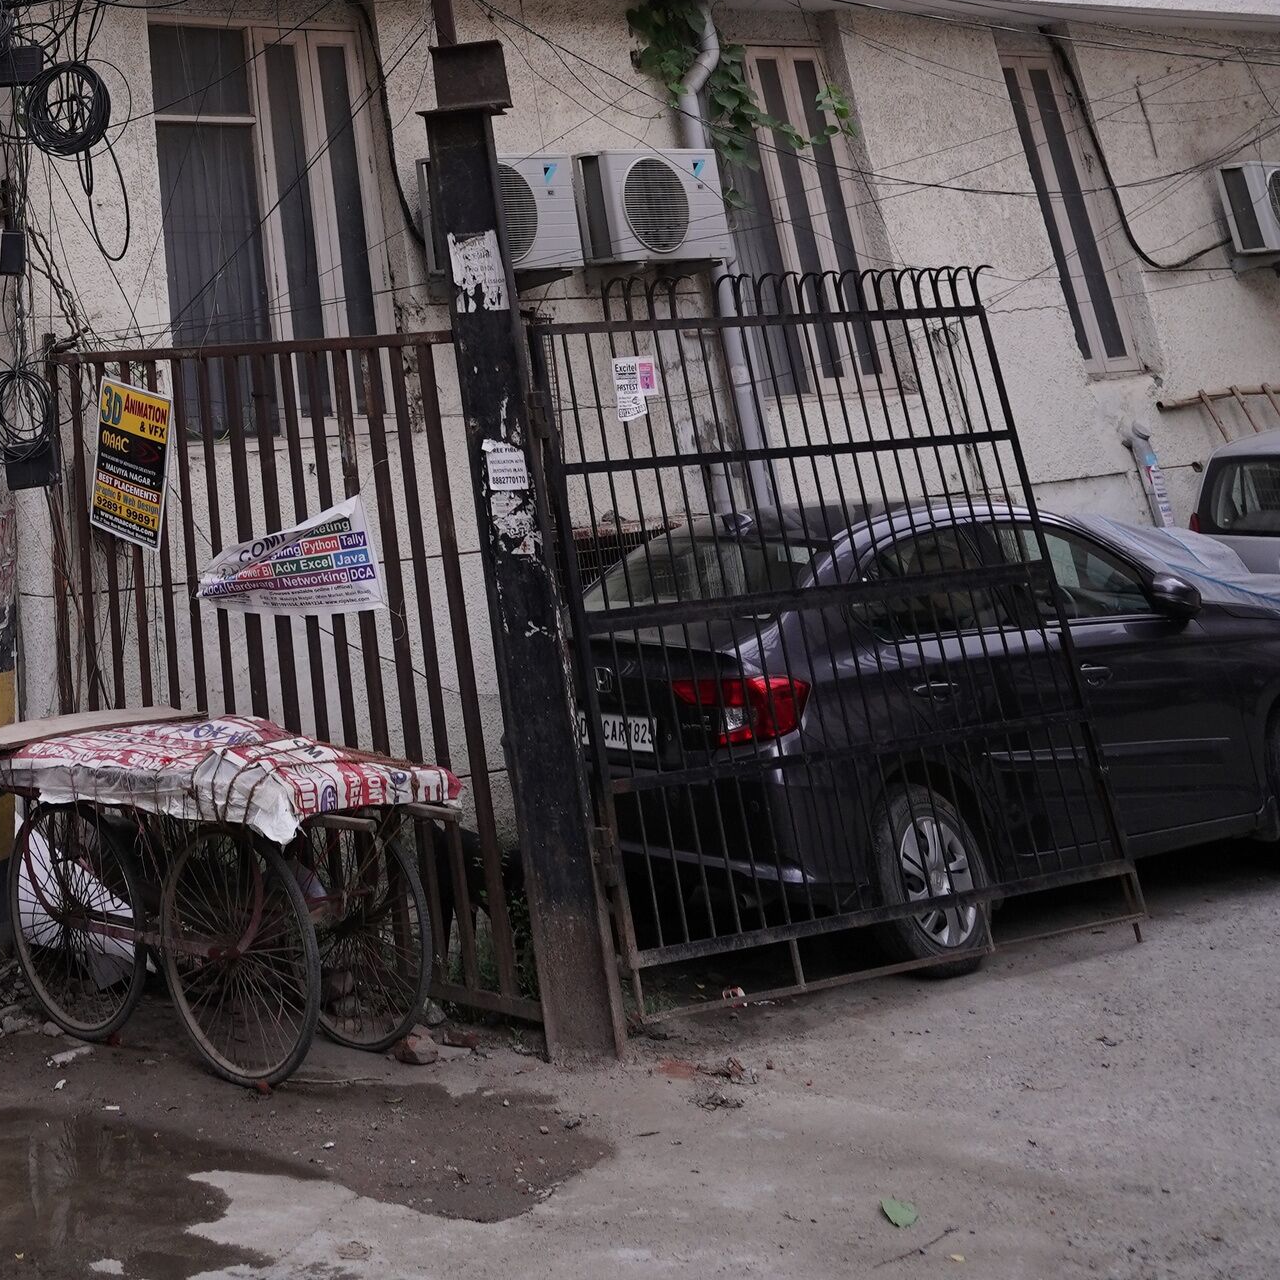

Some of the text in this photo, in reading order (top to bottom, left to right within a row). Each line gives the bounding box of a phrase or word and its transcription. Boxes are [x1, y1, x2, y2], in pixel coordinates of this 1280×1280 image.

[615, 363, 637, 372] Excitel
[101, 386, 122, 426] 3D
[102, 429, 130, 453] MAAC
[139, 421, 165, 439] & VFX
[105, 461, 129, 477] MALVIYA
[129, 470, 151, 485] NAGAR
[98, 471, 158, 502] BEST PLACEMENTS
[97, 496, 157, 527] 92891 99891
[303, 537, 339, 555] Python
[340, 533, 365, 549] Tally
[275, 561, 297, 574] Adv
[300, 557, 332, 571] Excel
[336, 552, 367, 567] Java
[227, 578, 275, 593] Hardware
[283, 569, 349, 589] Networking
[350, 567, 375, 581] DCA
